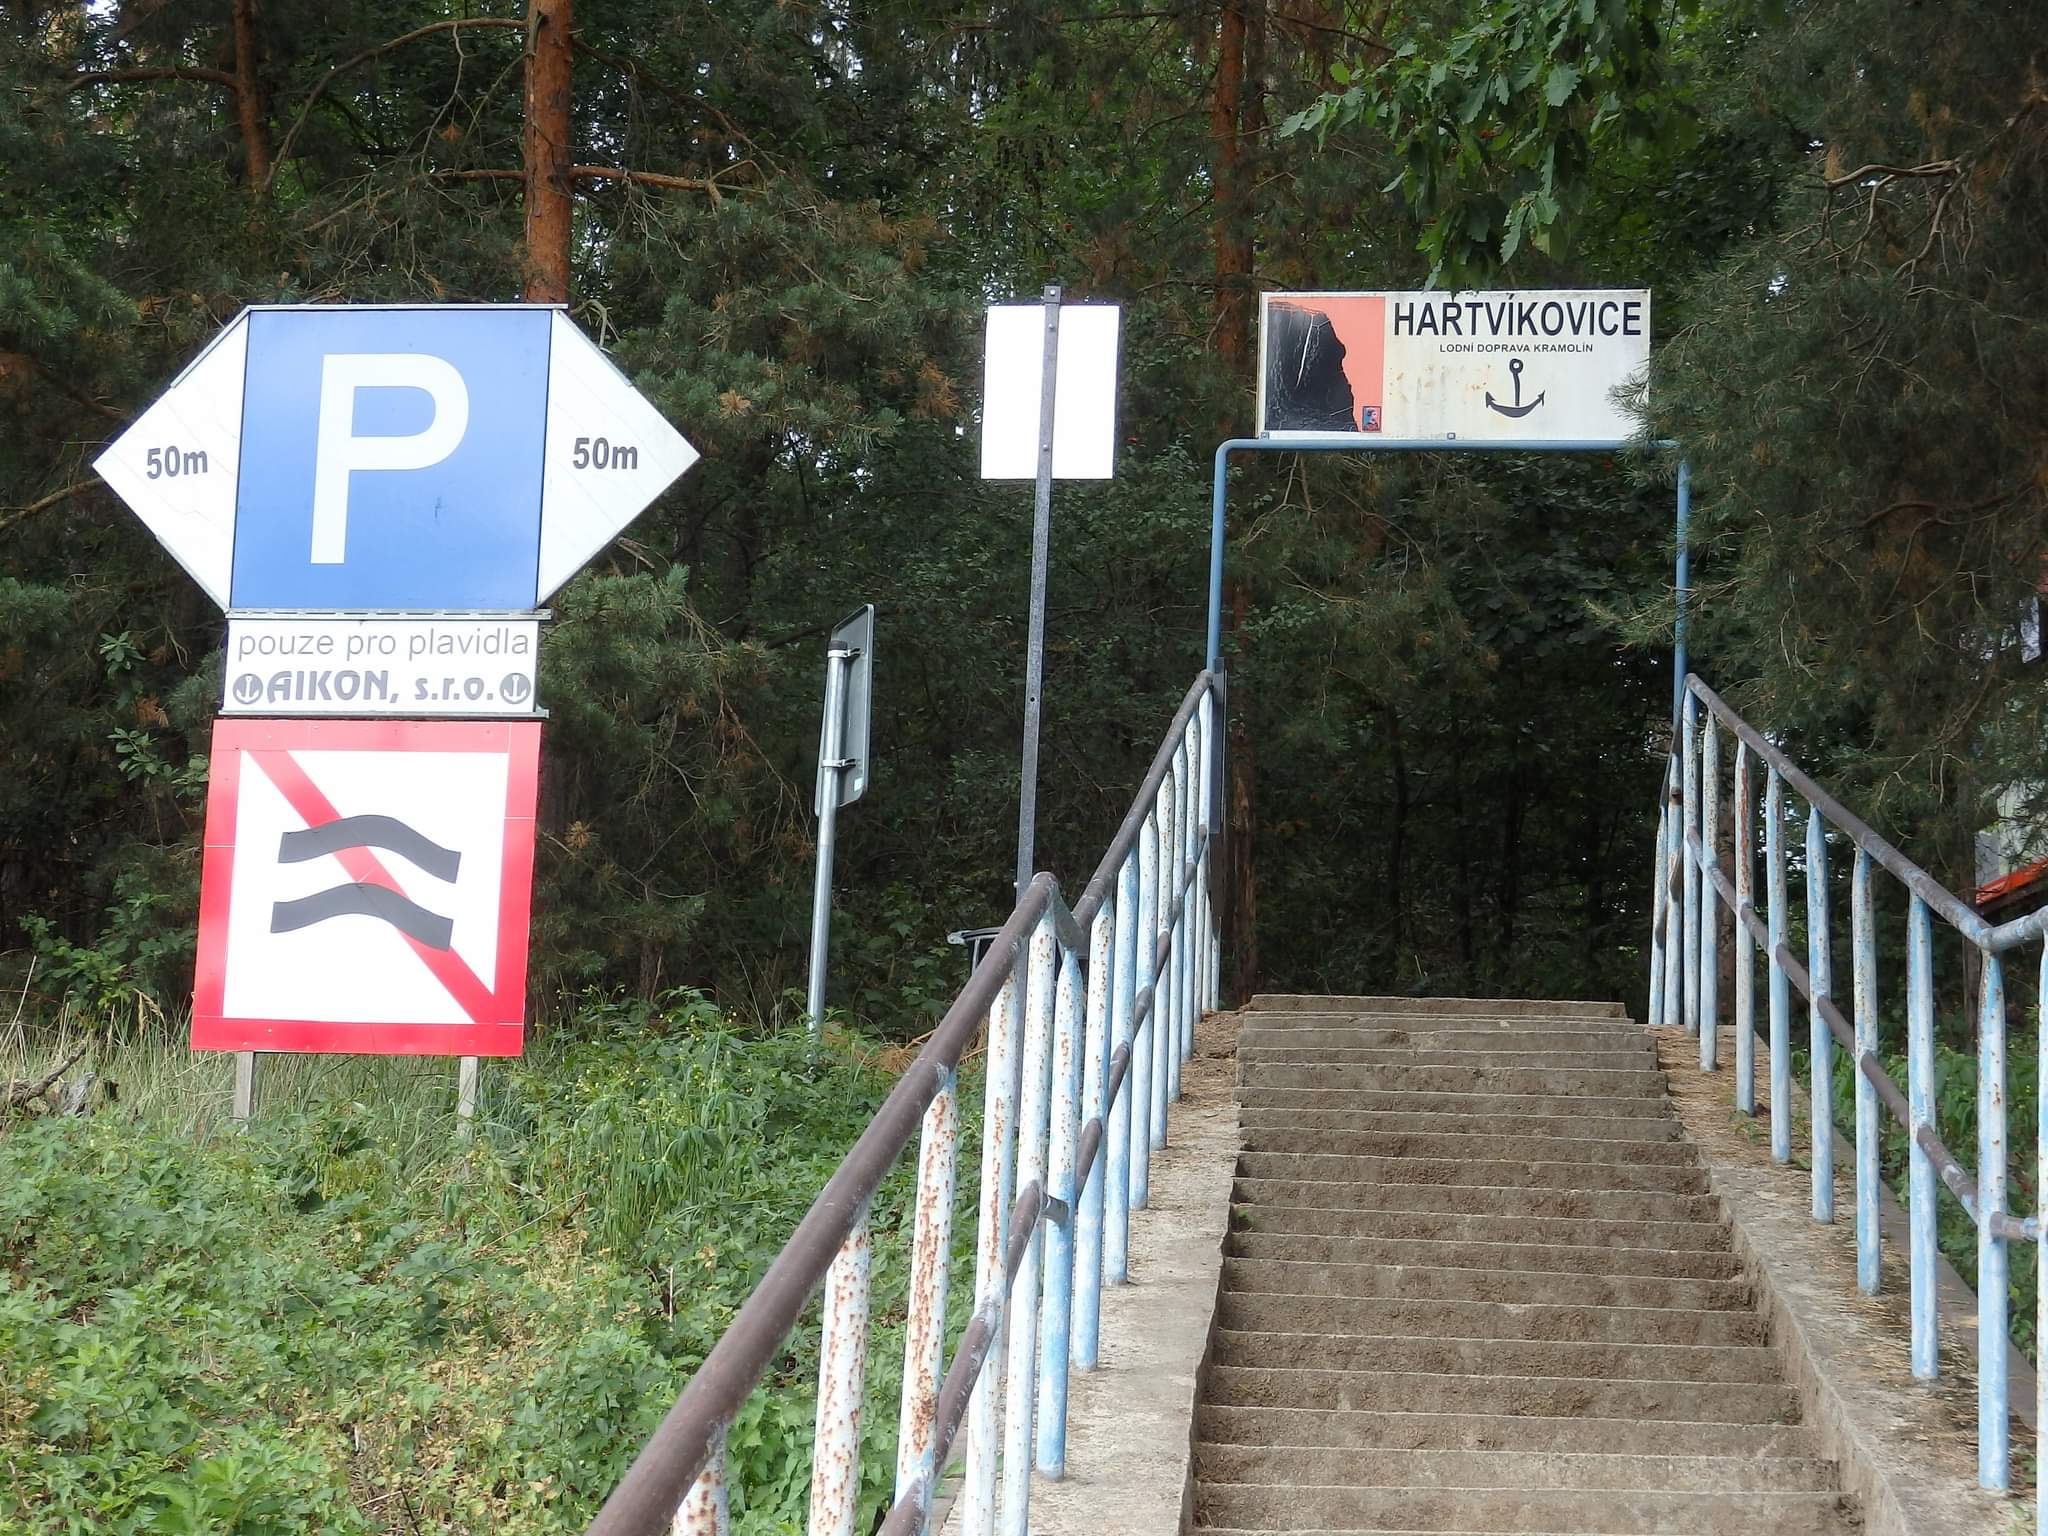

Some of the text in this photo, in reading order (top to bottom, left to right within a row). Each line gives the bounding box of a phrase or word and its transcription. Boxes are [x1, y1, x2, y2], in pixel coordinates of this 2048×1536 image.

[1393, 294, 1642, 336] HARTVÍKOVICE
[1439, 342, 1593, 353] LODNÍ DOPRAVA KRAMOLÍN
[146, 446, 208, 480] 50m
[310, 353, 469, 564] P
[573, 437, 638, 470] 50m
[238, 628, 529, 662] pouze pro plavidla
[267, 670, 493, 704] AIKON, s.r.o.
